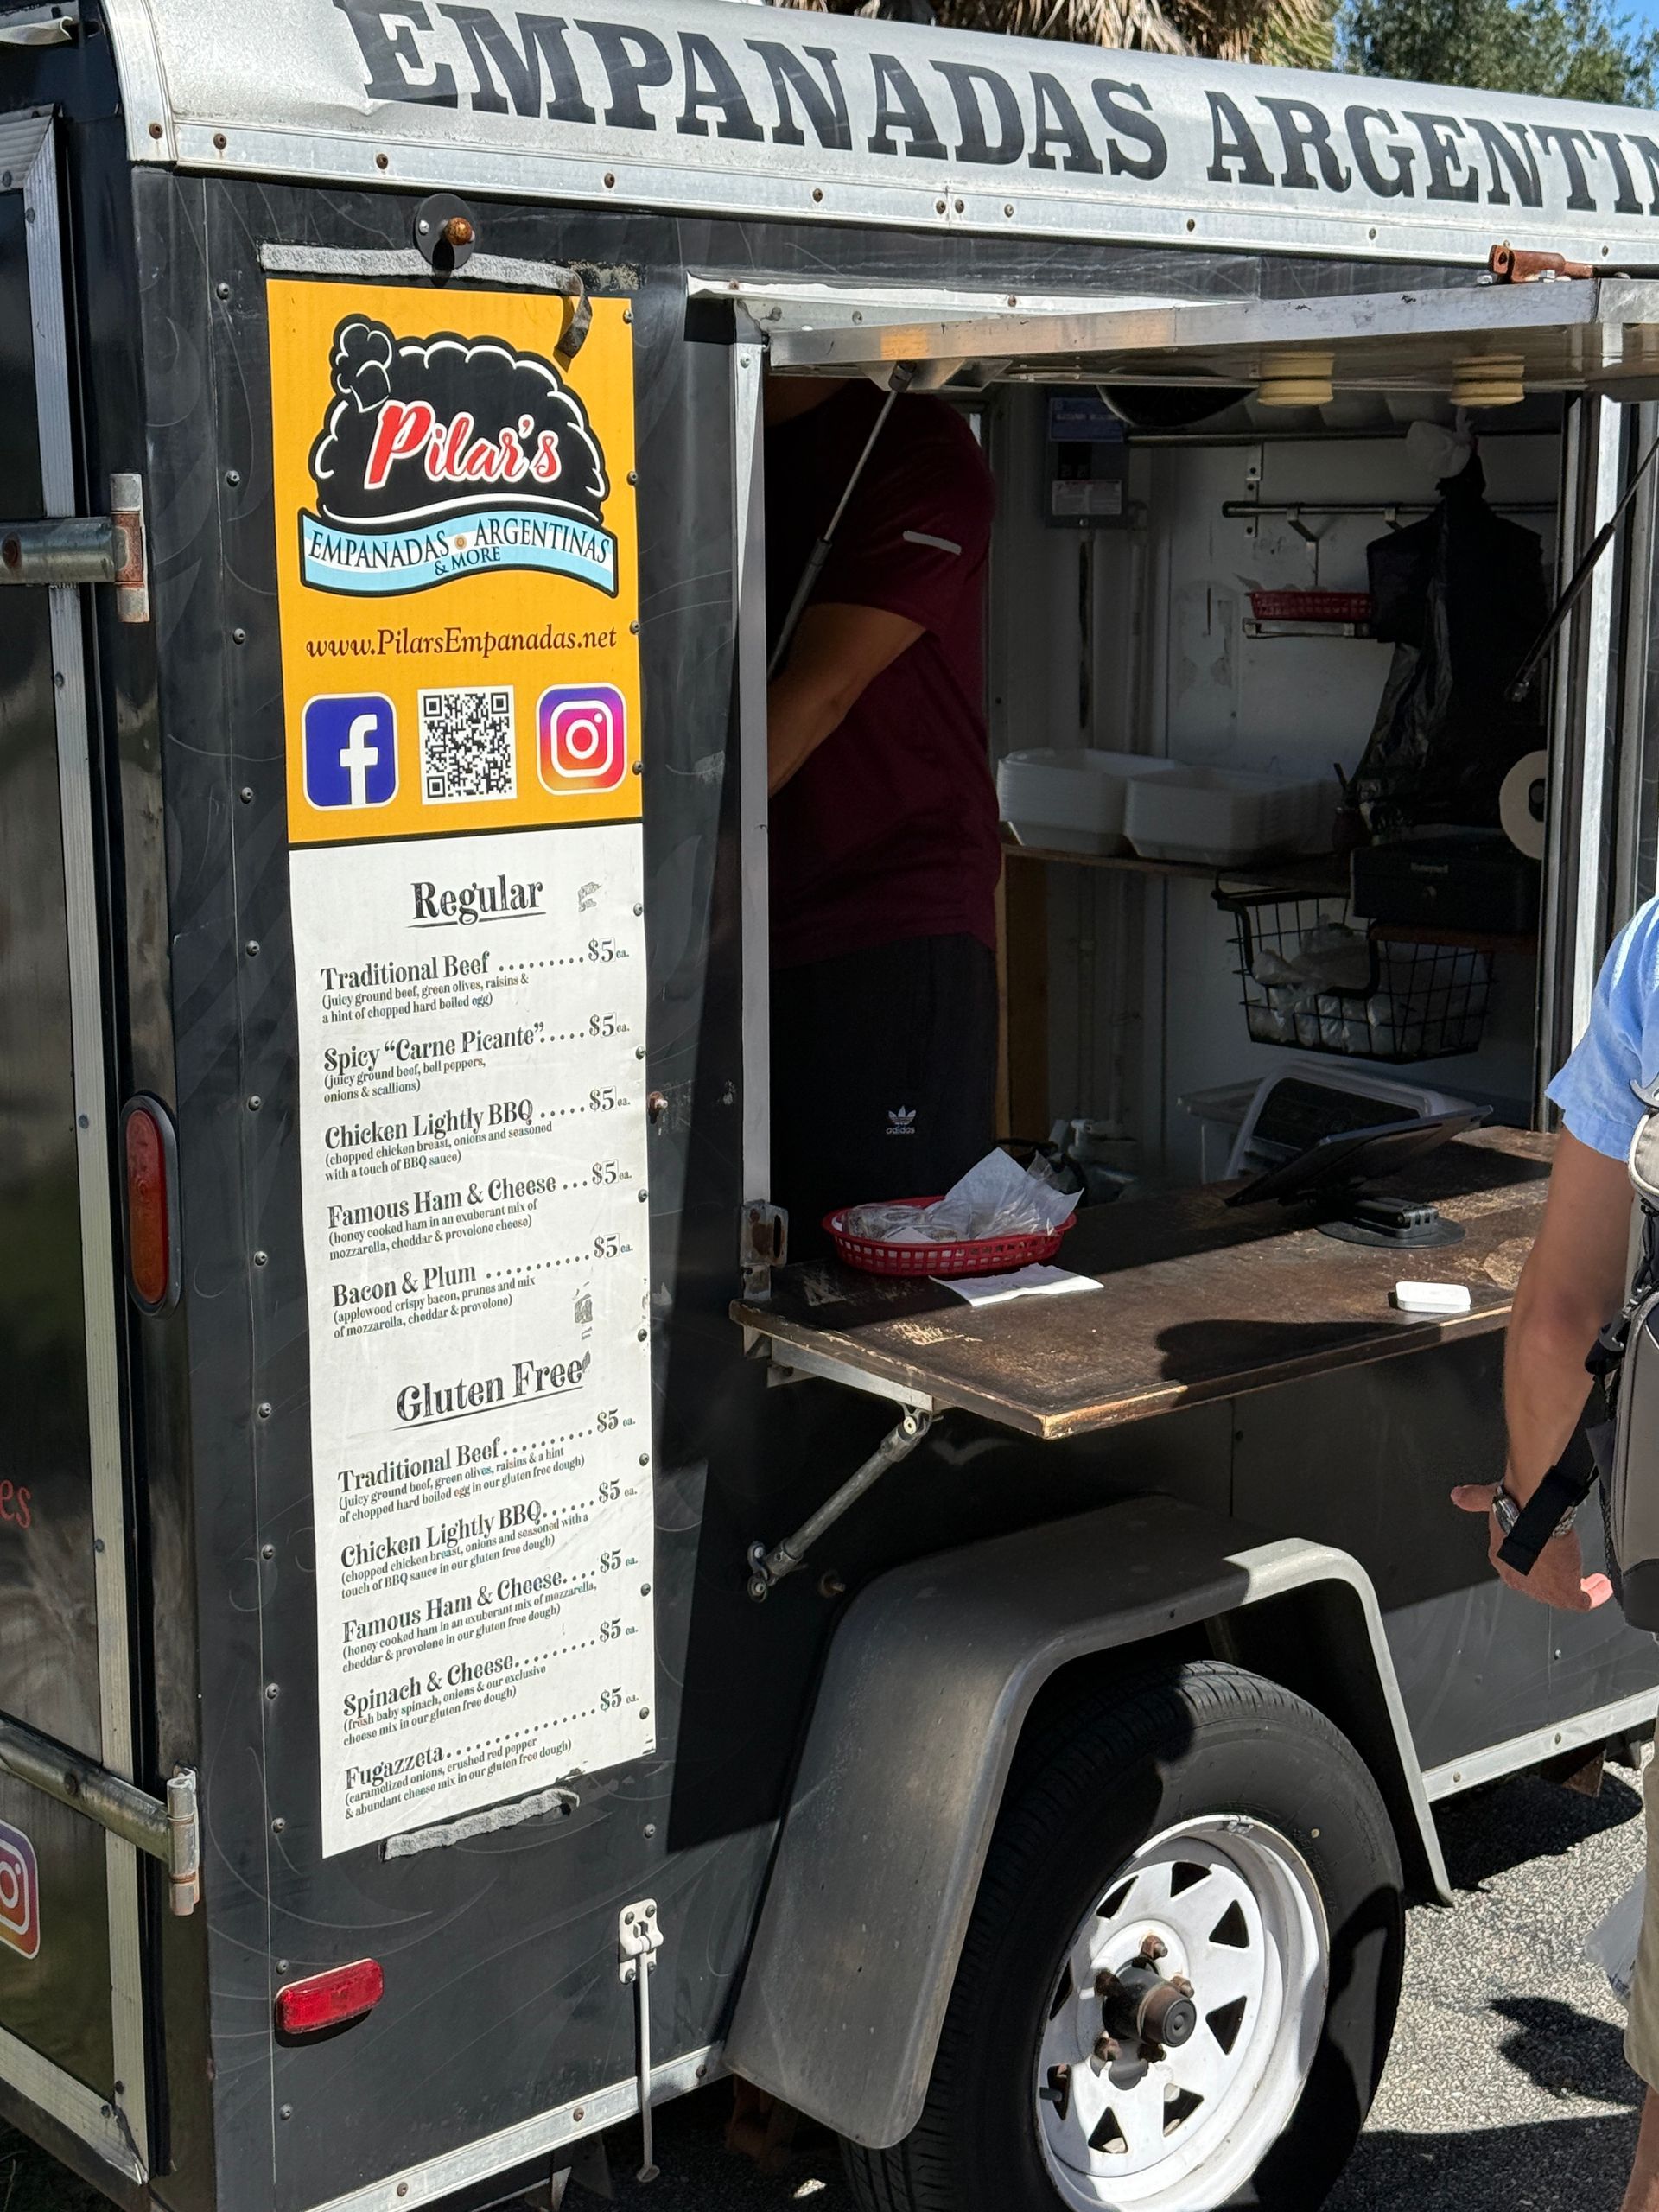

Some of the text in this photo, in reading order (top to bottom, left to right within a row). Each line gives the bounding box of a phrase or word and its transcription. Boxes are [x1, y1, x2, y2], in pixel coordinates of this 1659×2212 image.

[333, 0, 1168, 181] EMPANADAS
[308, 518, 610, 569] EMPANADAS ARGENTINAS
[434, 545, 501, 577] & MORE
[306, 623, 617, 659] www.PilarsEmpanadas.net
[410, 874, 543, 925] Regular
[320, 956, 439, 991] Traditional
[442, 950, 490, 977] Beef
[588, 938, 613, 962] $5
[354, 987, 392, 1006] ground
[394, 985, 419, 999] beef,
[421, 984, 450, 999] green
[452, 980, 483, 992] olives,
[486, 975, 518, 988] raisins
[520, 973, 529, 984] &
[322, 992, 493, 1023] a hint of chopped hard boiled egg)
[323, 1047, 380, 1076] Spicy
[589, 1014, 614, 1037] $5
[323, 1078, 420, 1103] onions & scallions)
[356, 1066, 394, 1085] ground
[396, 1063, 421, 1077] beef,
[423, 1060, 441, 1073] bell
[443, 1058, 486, 1074] peppers,
[324, 1120, 408, 1149] Chicken
[412, 1107, 484, 1139] Lightly
[487, 1098, 533, 1126] BBQ
[589, 1088, 614, 1111] $5
[375, 1143, 415, 1158] chicken
[416, 1138, 452, 1152] breast,
[454, 1133, 486, 1146] onions
[488, 1127, 506, 1141] and
[508, 1120, 552, 1138] seasoned
[325, 1149, 461, 1180] with a touch of BBQ sauce)
[327, 1200, 410, 1229] Famous
[413, 1189, 462, 1214] Ham
[467, 1182, 483, 1205] &
[487, 1176, 556, 1201] Cheese
[592, 1161, 616, 1185] $5
[366, 1221, 403, 1238] cooked
[405, 1219, 427, 1231] ham
[429, 1216, 439, 1227] in
[442, 1216, 454, 1225] an
[455, 1205, 505, 1223] exuberant
[507, 1201, 525, 1214] mix
[527, 1198, 537, 1211] of
[329, 1214, 531, 1261] mozzarella, cheddar & provolone cheese)
[332, 1281, 397, 1307] Bacon
[401, 1271, 418, 1294] &
[423, 1265, 476, 1290] Plum
[594, 1236, 618, 1258] $5
[395, 1298, 424, 1312] crispy
[427, 1292, 460, 1305] bacon,
[461, 1285, 496, 1301] prunes
[497, 1277, 515, 1292] and
[517, 1274, 535, 1287] mix
[334, 1293, 512, 1338] of mozzarella, cheddar & provolone)
[396, 1360, 583, 1421] Gluten Free
[337, 1447, 451, 1492] Traditional
[456, 1436, 500, 1466] Beef
[596, 1408, 618, 1433] $5
[340, 1535, 420, 1567] Chicken
[426, 1513, 494, 1548] Lightly
[498, 1499, 541, 1529] BBQ
[598, 1478, 620, 1503] $5
[341, 1609, 421, 1643] Famous
[425, 1595, 472, 1621] Ham
[477, 1585, 493, 1606] &
[497, 1571, 562, 1600] Cheese
[600, 1548, 621, 1573] $5
[343, 1676, 422, 1719] Spinach
[426, 1670, 442, 1692] &
[447, 1655, 512, 1686] Cheese
[599, 1618, 620, 1643] $5
[376, 1707, 398, 1721] baby
[401, 1694, 441, 1715] spinach,
[443, 1686, 474, 1702] onions
[476, 1681, 484, 1692] &
[486, 1677, 503, 1689] our
[505, 1665, 545, 1684] exclusive
[343, 1685, 516, 1745] cheese mix in our gluten free dough)
[344, 1745, 444, 1790] Fugazzeta
[600, 1686, 621, 1712] $5
[345, 1738, 571, 1819] & abundant cheese mix in our gluten free dough)
[410, 1767, 445, 1783] onions,
[447, 1751, 485, 1772] crushed
[487, 1745, 502, 1760] red
[505, 1738, 537, 1758] pepper
